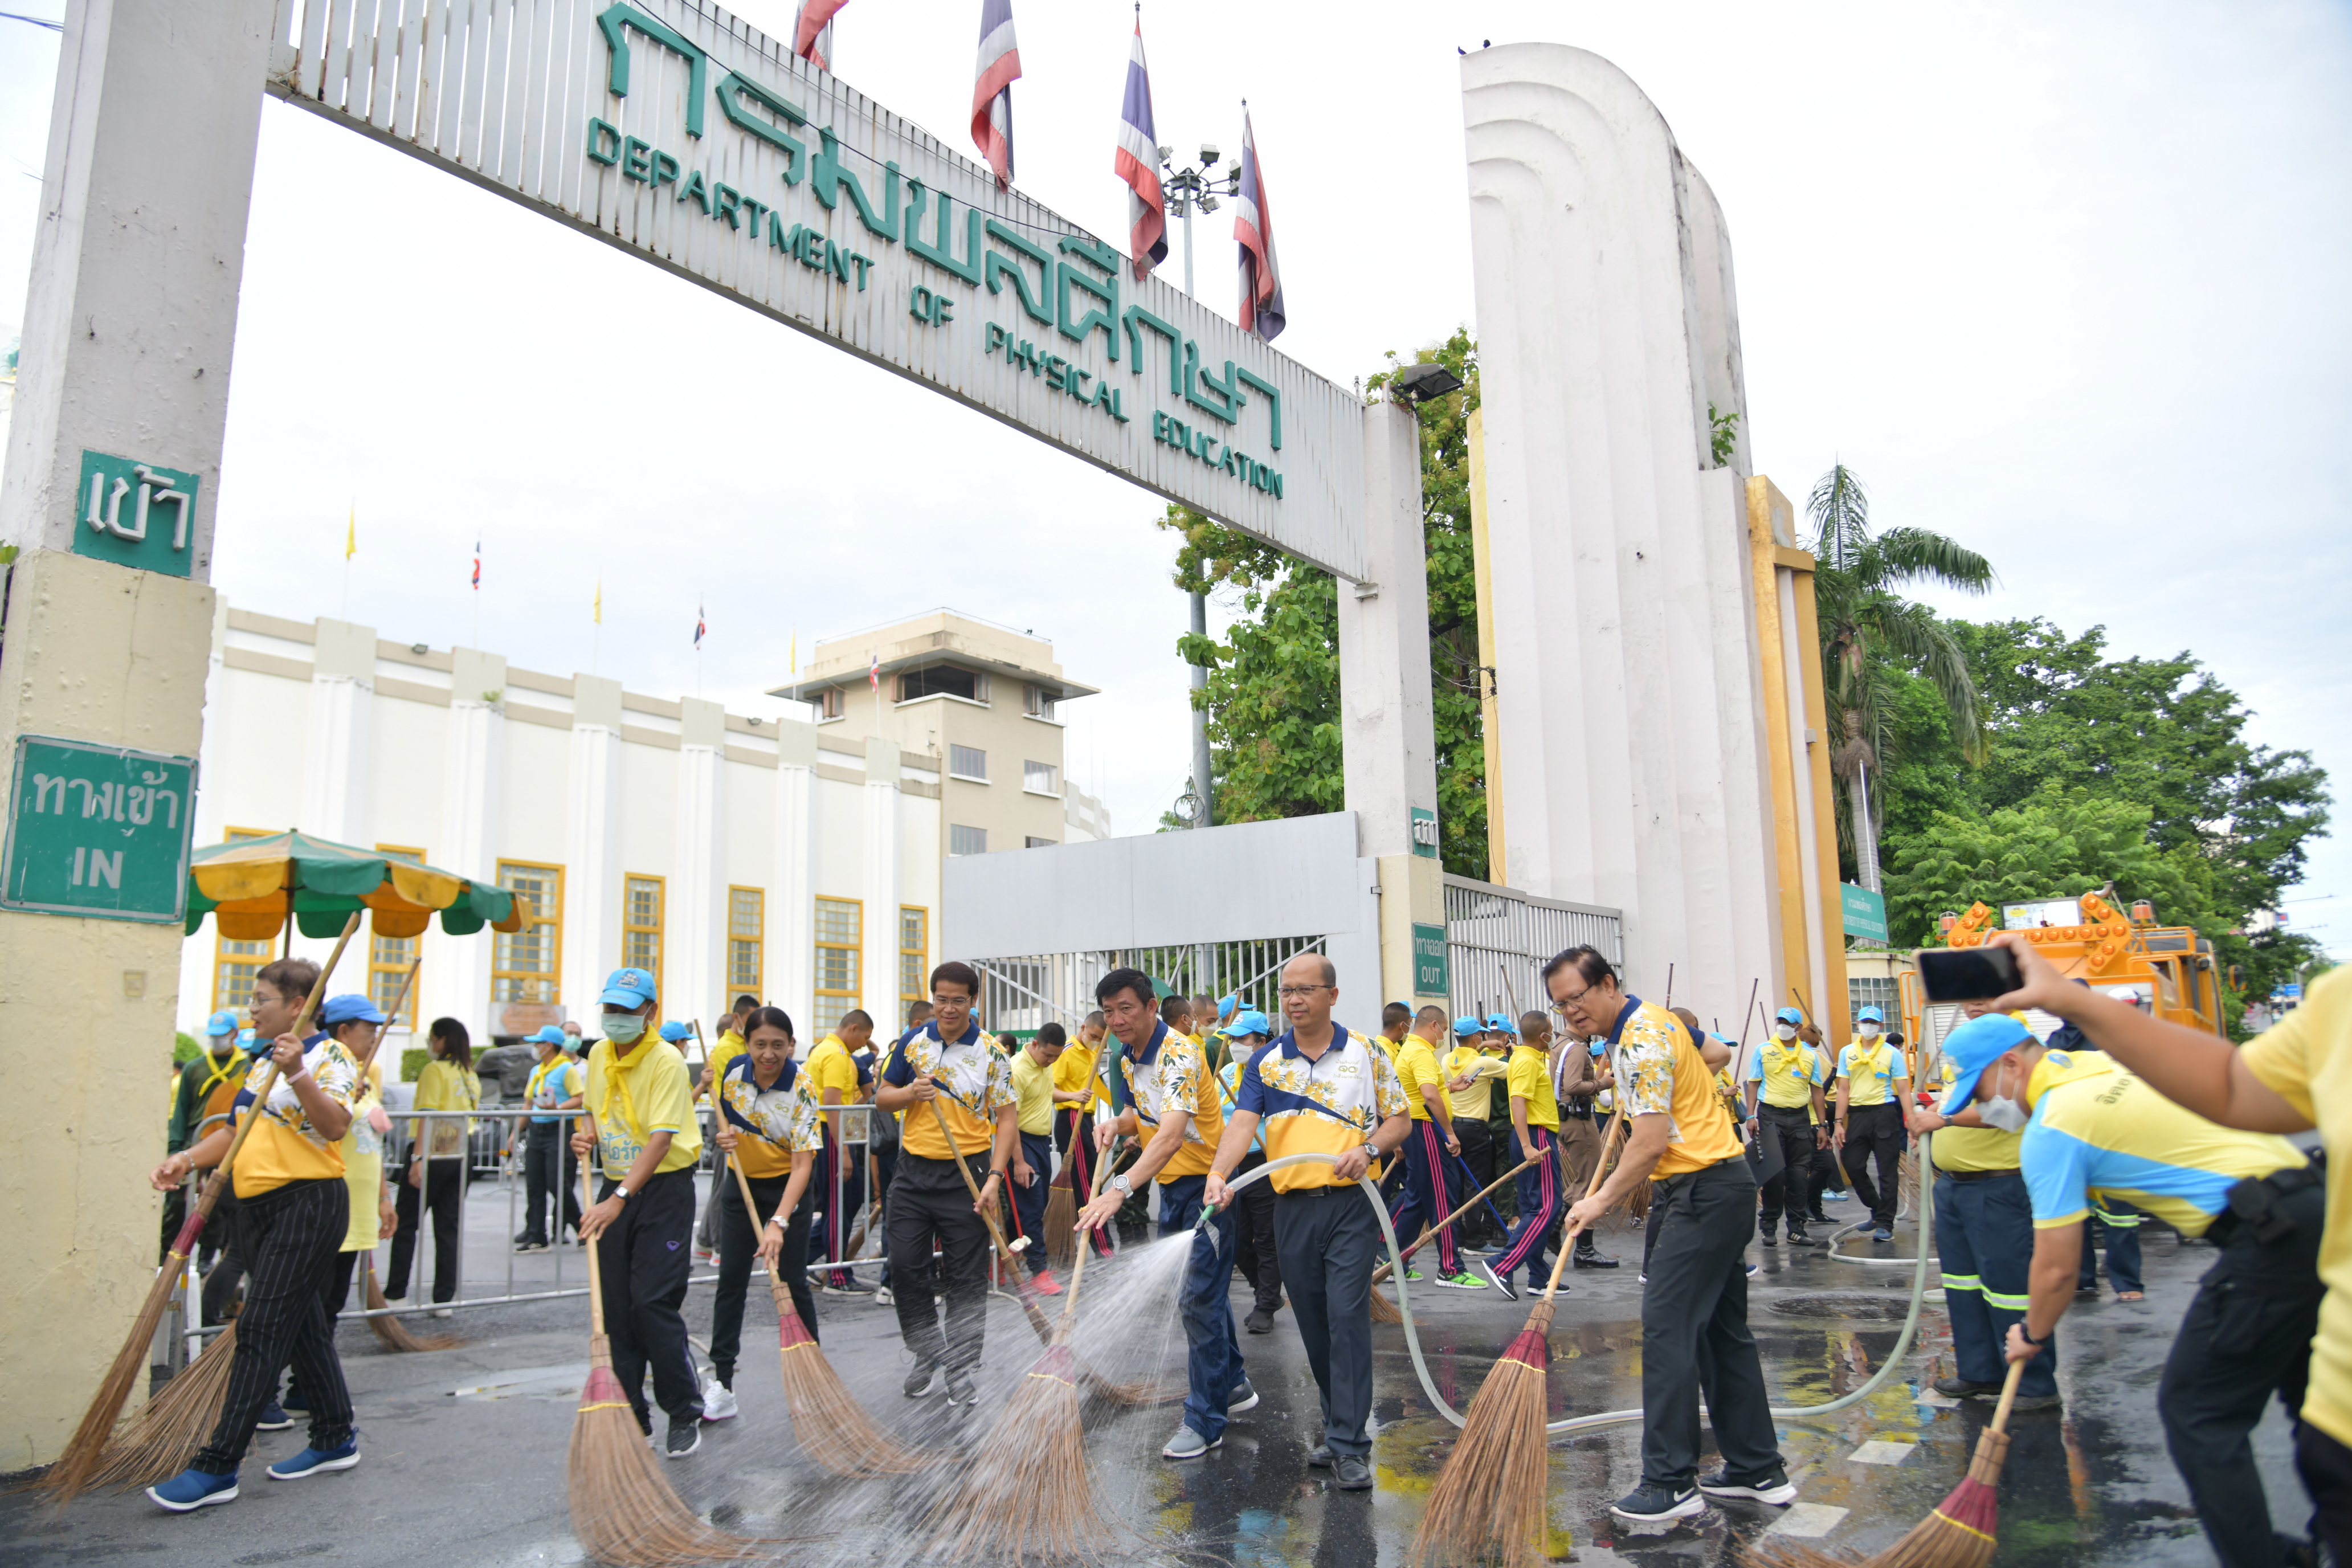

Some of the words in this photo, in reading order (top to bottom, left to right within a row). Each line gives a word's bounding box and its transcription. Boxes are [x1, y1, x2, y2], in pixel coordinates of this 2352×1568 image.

[597, 1, 1282, 450] กรมพลศึกษา
[587, 117, 875, 292] DEPARTMENT
[910, 284, 954, 328] OF
[985, 321, 1130, 423] PHYSICAL
[1153, 410, 1283, 500] EDUCATION
[87, 464, 190, 551] เข้า
[32, 770, 179, 829] ทางเข้า
[72, 847, 123, 889] IN
[1416, 937, 1444, 957] ทางออก
[1422, 966, 1440, 984] OUT
